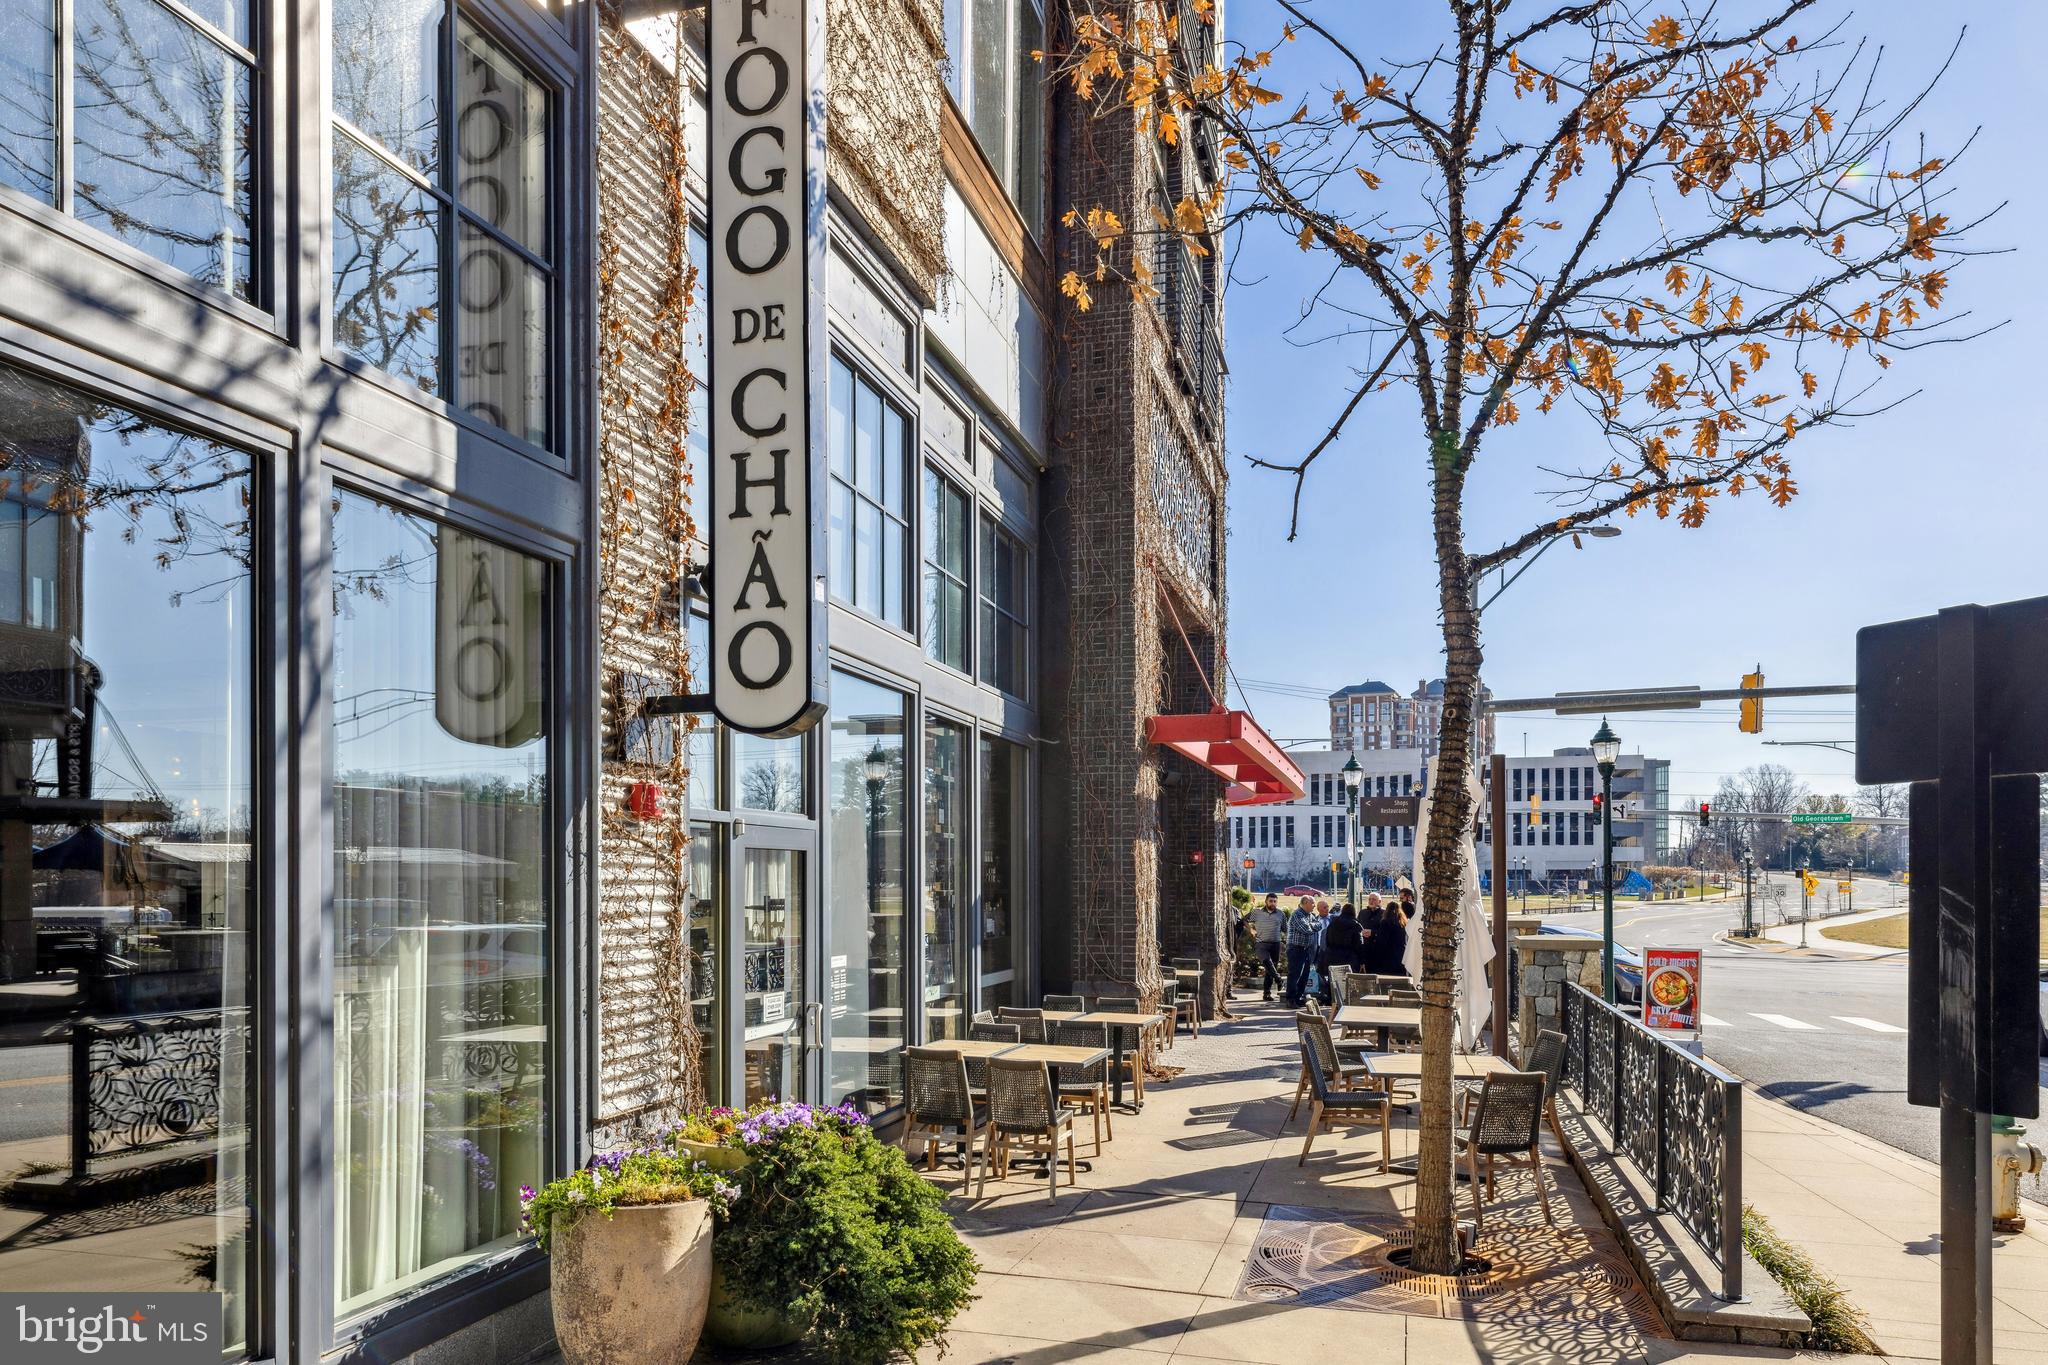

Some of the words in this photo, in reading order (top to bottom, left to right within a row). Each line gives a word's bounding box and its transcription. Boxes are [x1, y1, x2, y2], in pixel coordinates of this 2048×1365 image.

[725, 0, 790, 275] FOGO
[732, 304, 786, 346] DE
[728, 367, 792, 691] CHÃO
[1805, 815, 1844, 823] Georgetown
[1649, 957, 1667, 967] COLD
